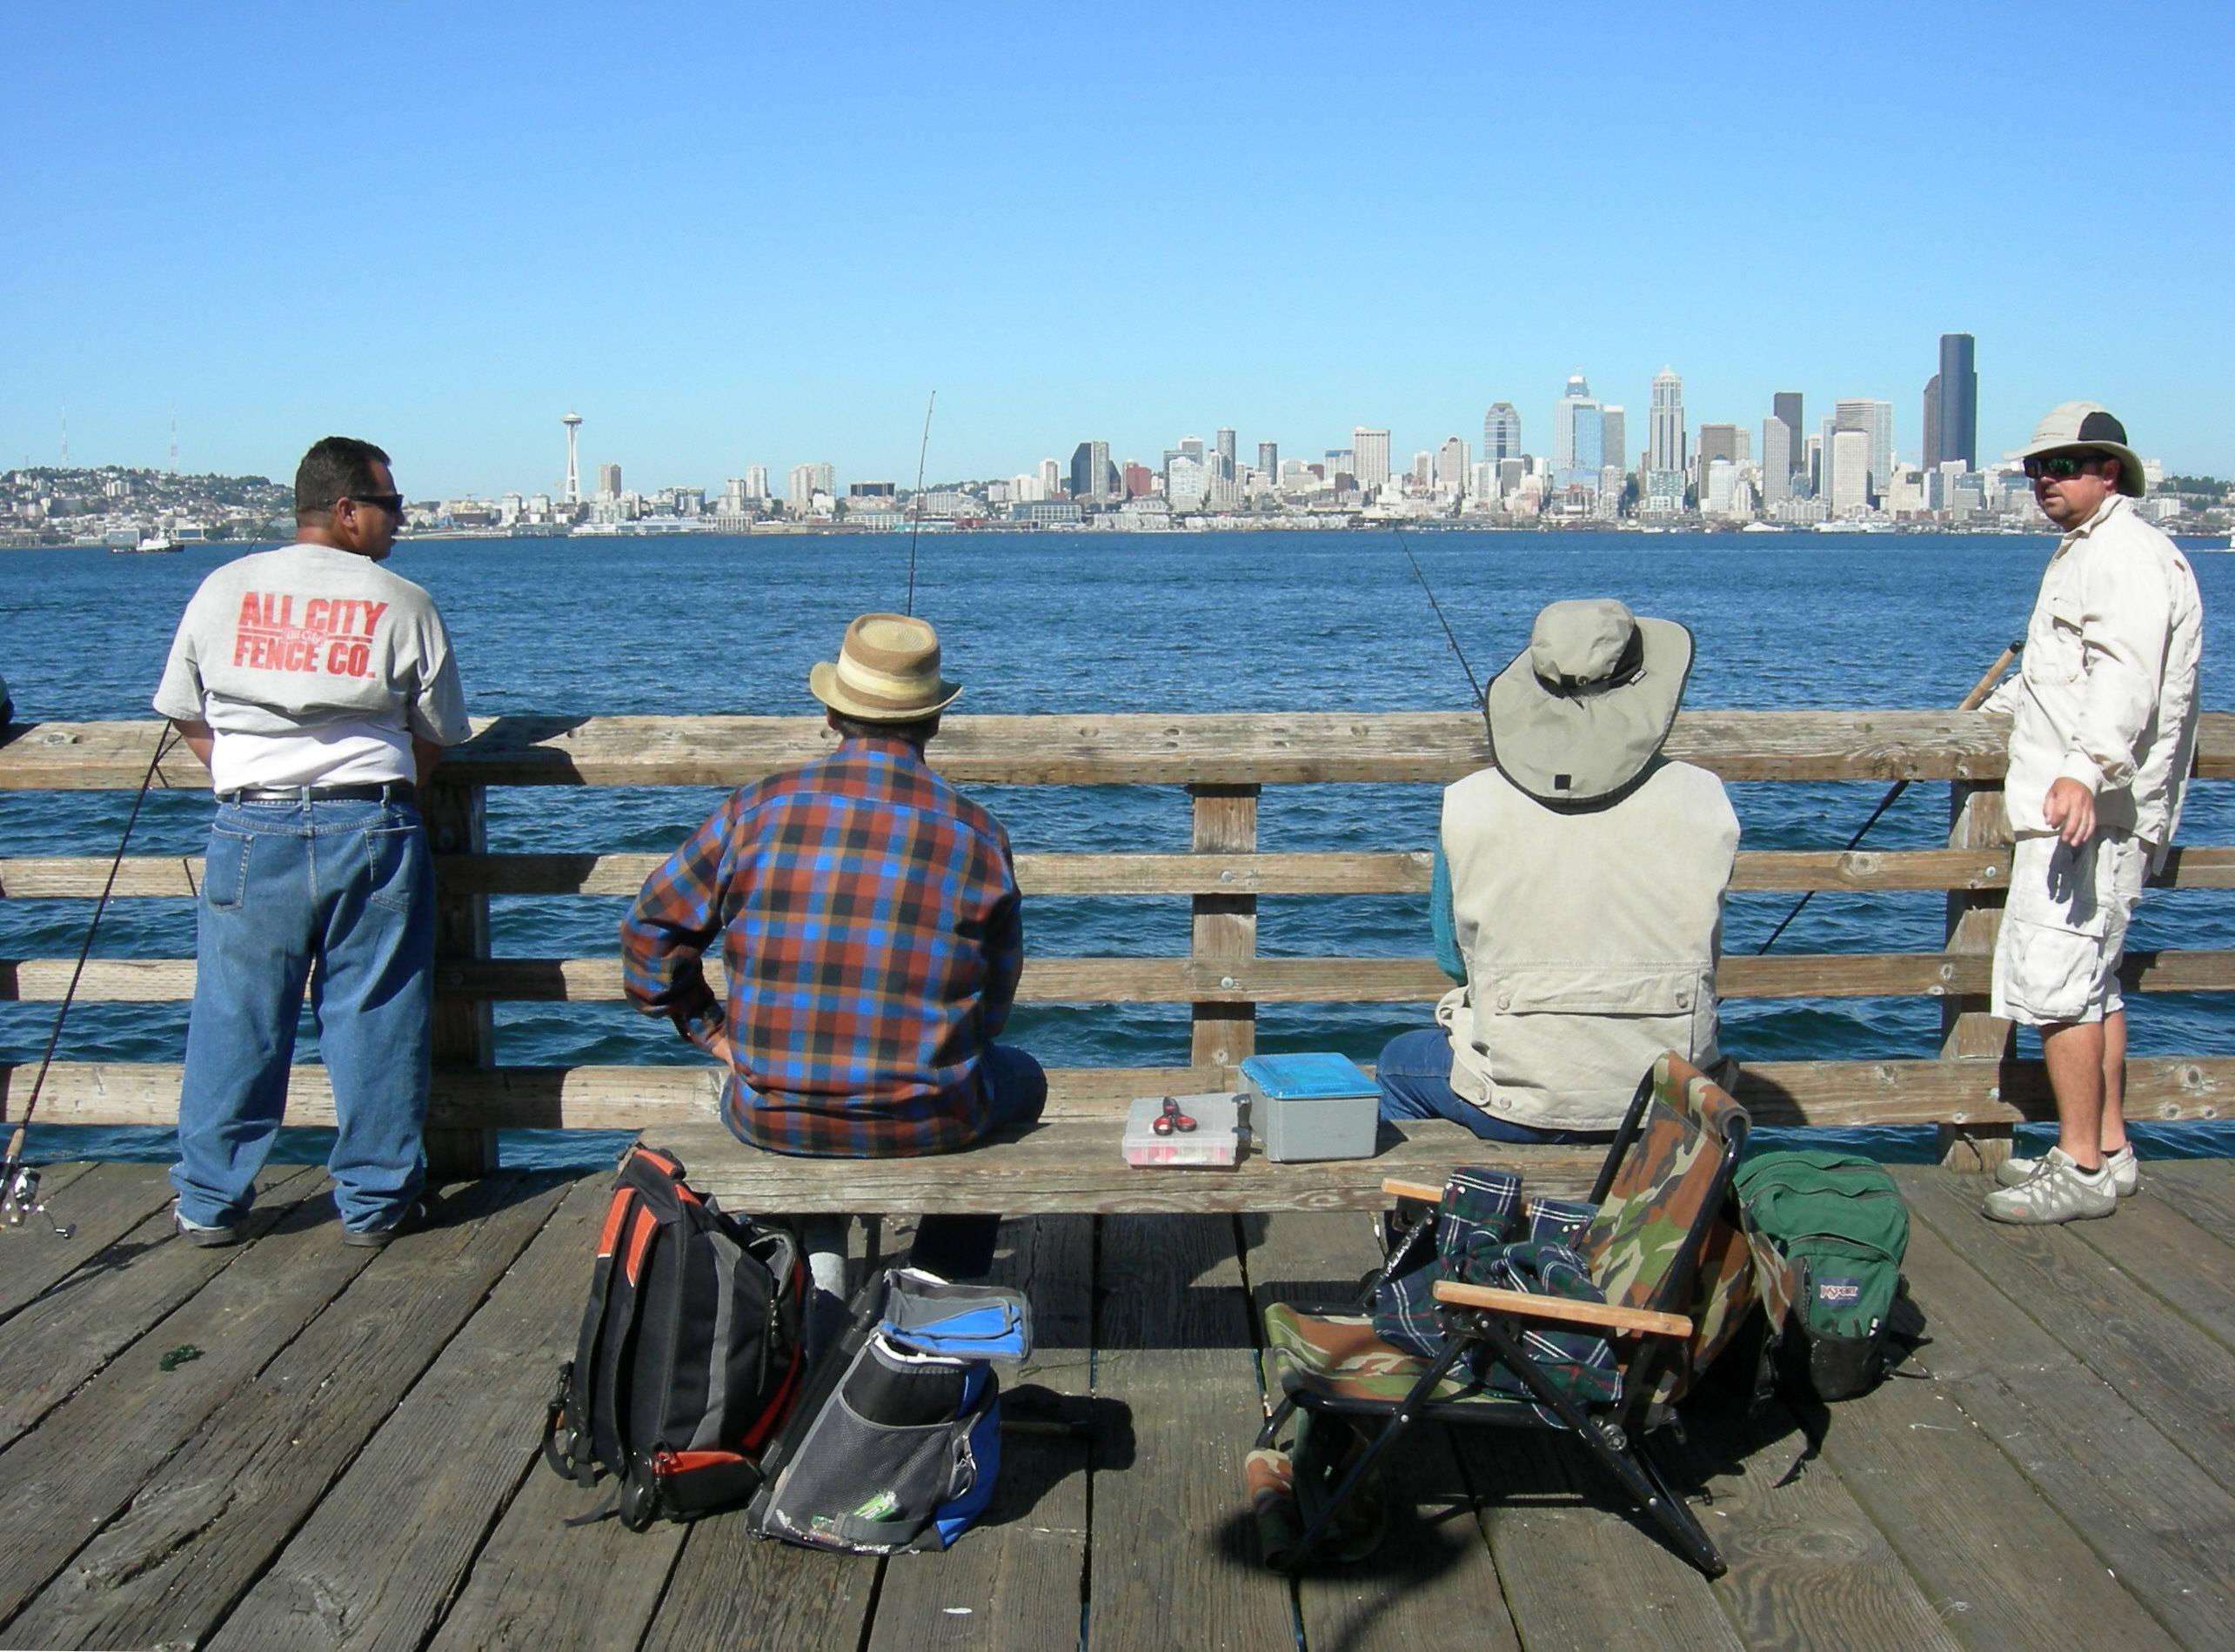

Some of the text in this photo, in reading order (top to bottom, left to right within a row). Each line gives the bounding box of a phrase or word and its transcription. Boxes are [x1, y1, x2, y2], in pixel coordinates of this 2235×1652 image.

[238, 592, 388, 636] ALL CITY
[233, 634, 376, 679] FENCE CO.
